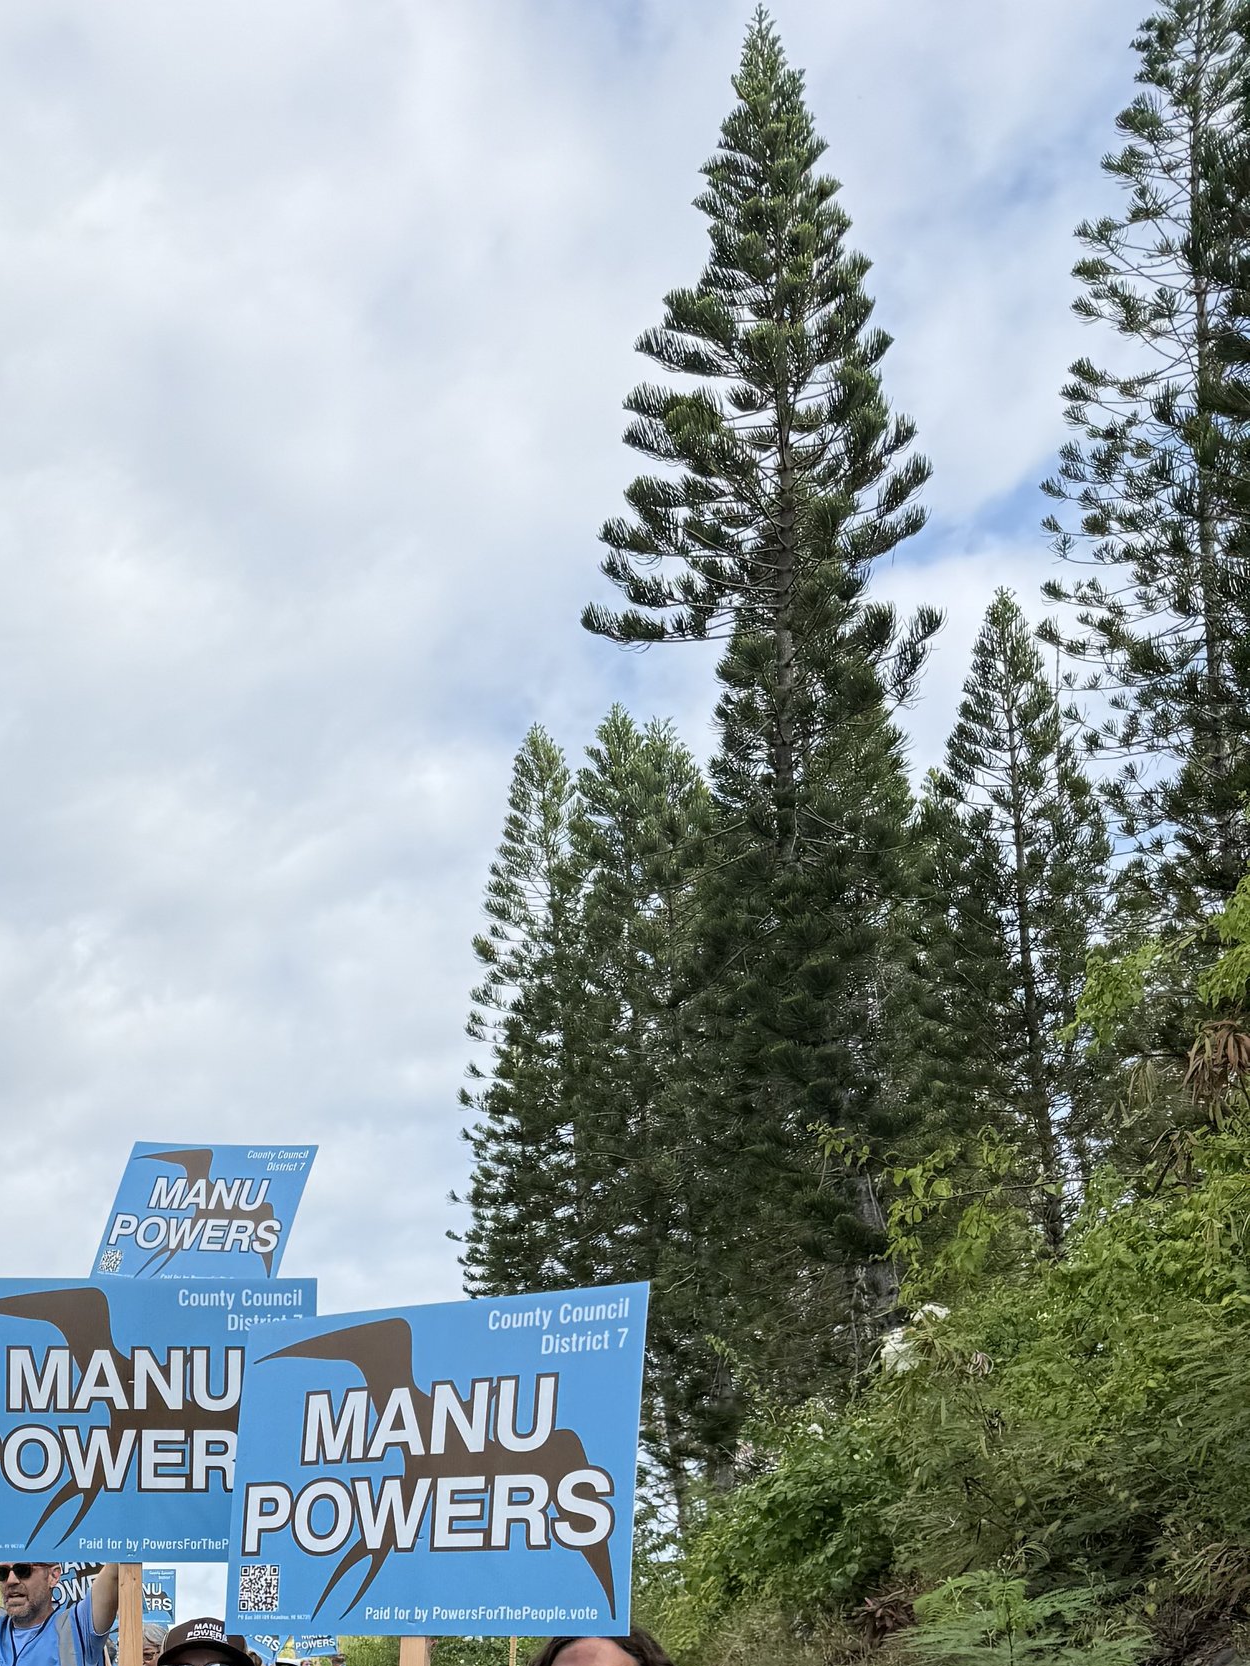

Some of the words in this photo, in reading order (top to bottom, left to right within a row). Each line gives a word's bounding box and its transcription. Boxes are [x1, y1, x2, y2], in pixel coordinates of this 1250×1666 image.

[247, 1150, 276, 1160] County
[277, 1150, 309, 1159] Council
[267, 1162, 297, 1171] District
[298, 1162, 306, 1171] 7
[147, 1176, 272, 1211] MANU
[107, 1213, 283, 1254] POWERS
[178, 1289, 235, 1310] County
[241, 1289, 303, 1306] Council
[488, 1308, 552, 1332] County
[558, 1297, 630, 1322] Council
[540, 1330, 609, 1355] District
[616, 1328, 629, 1349] 7
[6, 1345, 245, 1413] MANU
[300, 1371, 560, 1467] MANU
[241, 1463, 616, 1557] POWERS
[79, 1537, 103, 1550] Paid
[105, 1537, 123, 1550] for
[125, 1537, 139, 1553] by
[142, 1537, 229, 1551] PowersForTheP
[364, 1606, 390, 1621] Paid
[392, 1606, 411, 1621] for
[413, 1606, 429, 1622] by
[432, 1605, 599, 1622] PowersForThePeople.vote
[194, 1623, 222, 1632] MANU
[295, 1638, 336, 1650] POWERS
